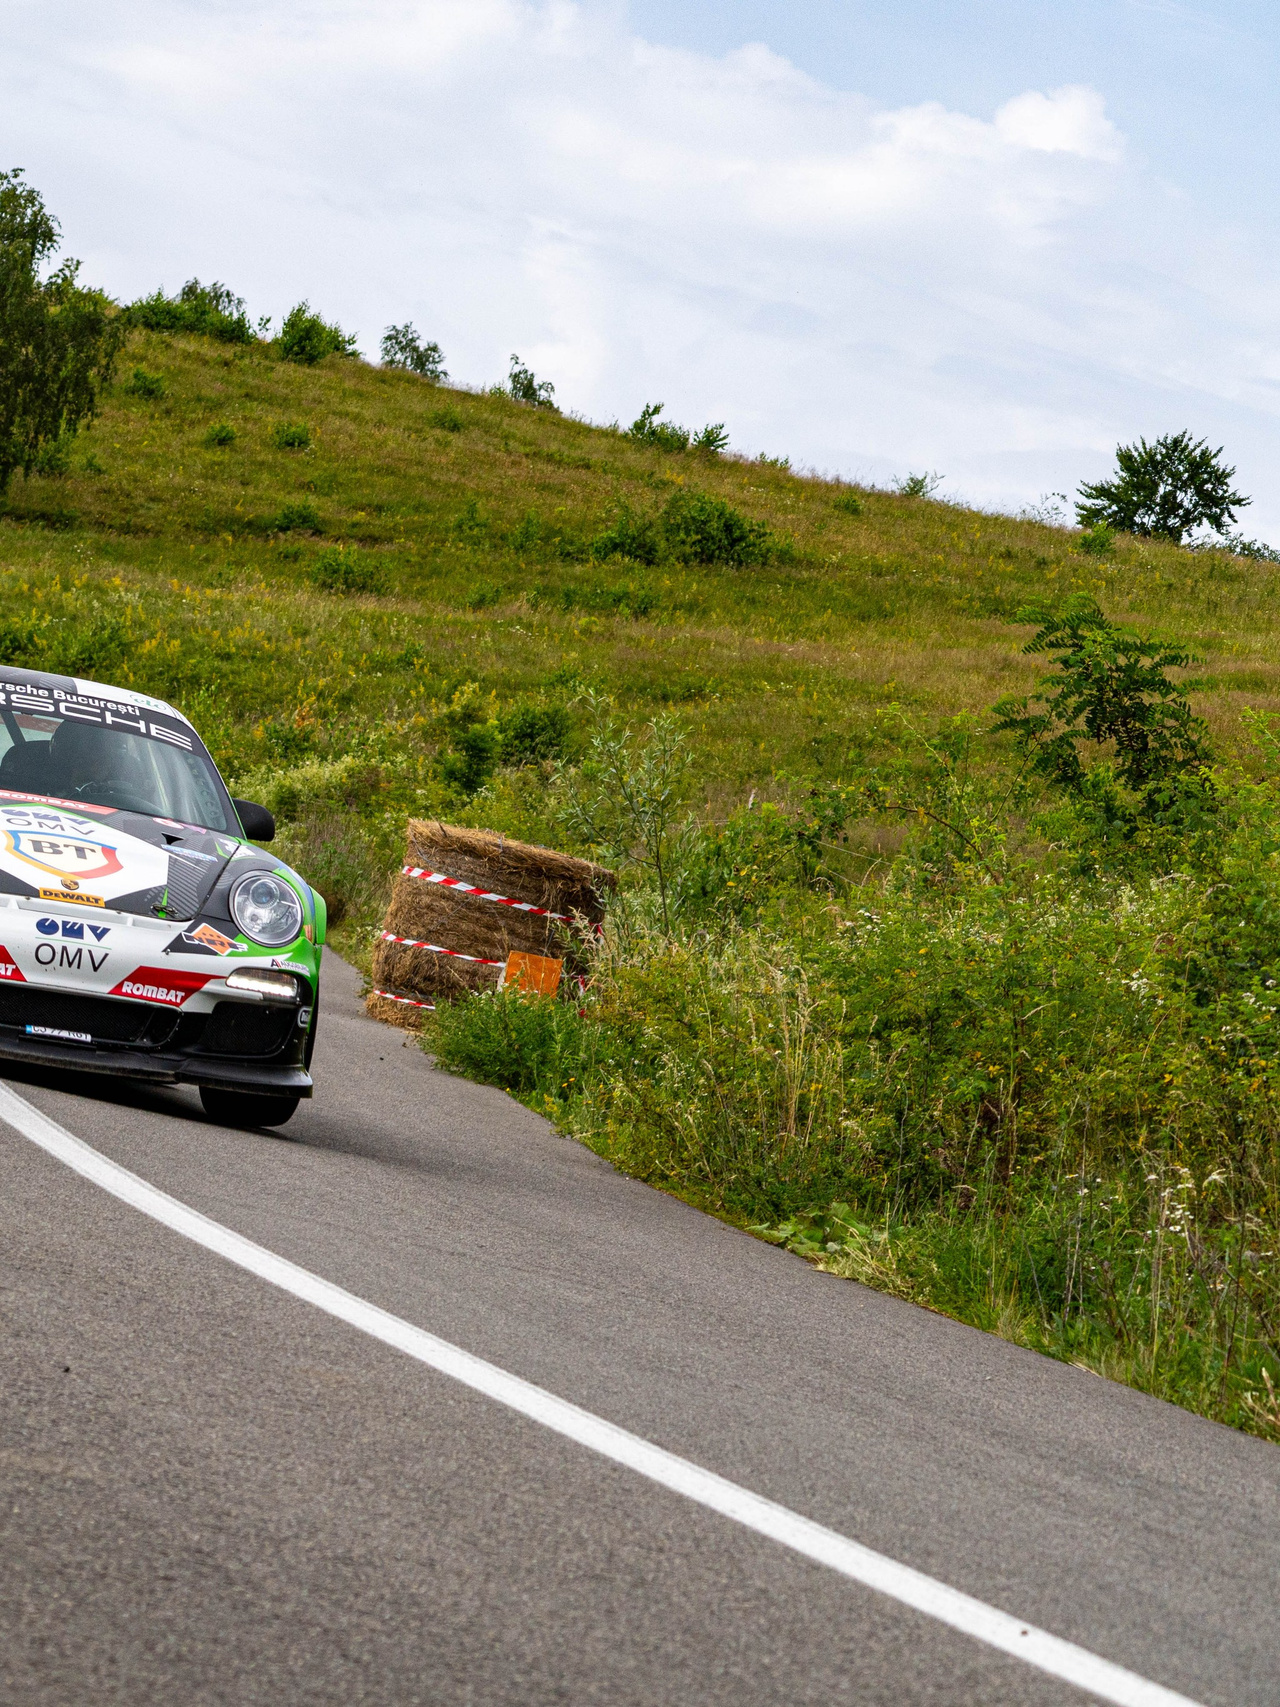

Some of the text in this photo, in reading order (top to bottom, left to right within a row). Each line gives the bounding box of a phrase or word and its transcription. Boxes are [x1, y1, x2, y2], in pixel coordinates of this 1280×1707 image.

[54, 689, 141, 716] București
[6, 817, 95, 835] OMV
[27, 838, 97, 861] BT
[34, 943, 110, 973] OMV
[122, 981, 186, 1004] ROMBAT
